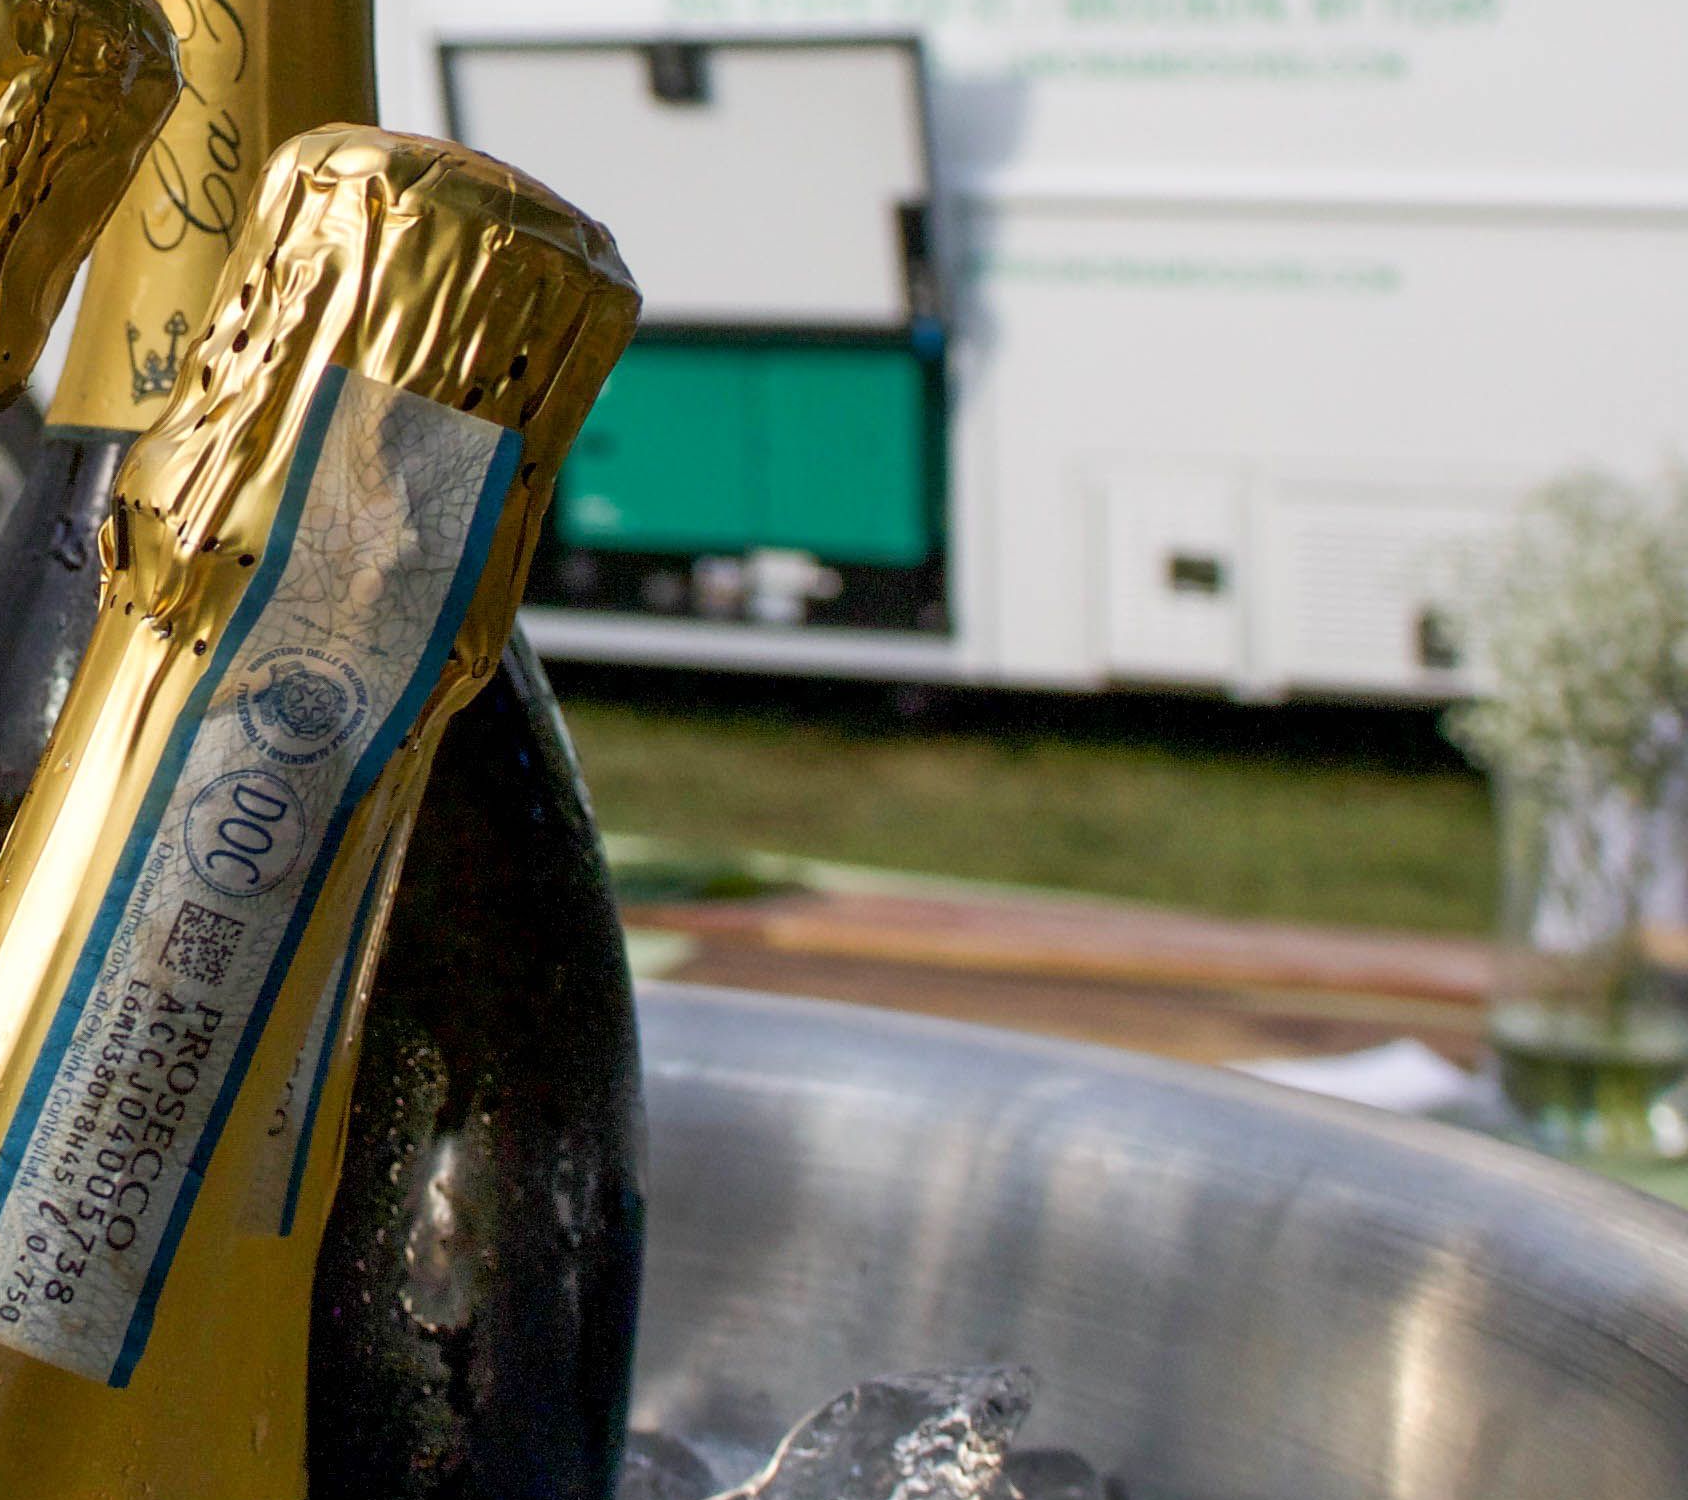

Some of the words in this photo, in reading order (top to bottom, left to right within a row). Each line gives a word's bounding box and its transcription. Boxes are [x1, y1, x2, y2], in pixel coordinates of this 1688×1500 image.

[307, 647, 341, 665] DELLE
[237, 683, 261, 743] FORESTALI
[206, 783, 288, 884] DOC
[101, 842, 174, 985] Denominazione
[62, 1014, 103, 1083] Origine
[19, 1087, 72, 1188] Controllata
[106, 1001, 224, 1251] PROSECCO
[0, 1234, 49, 1324] 0.750
